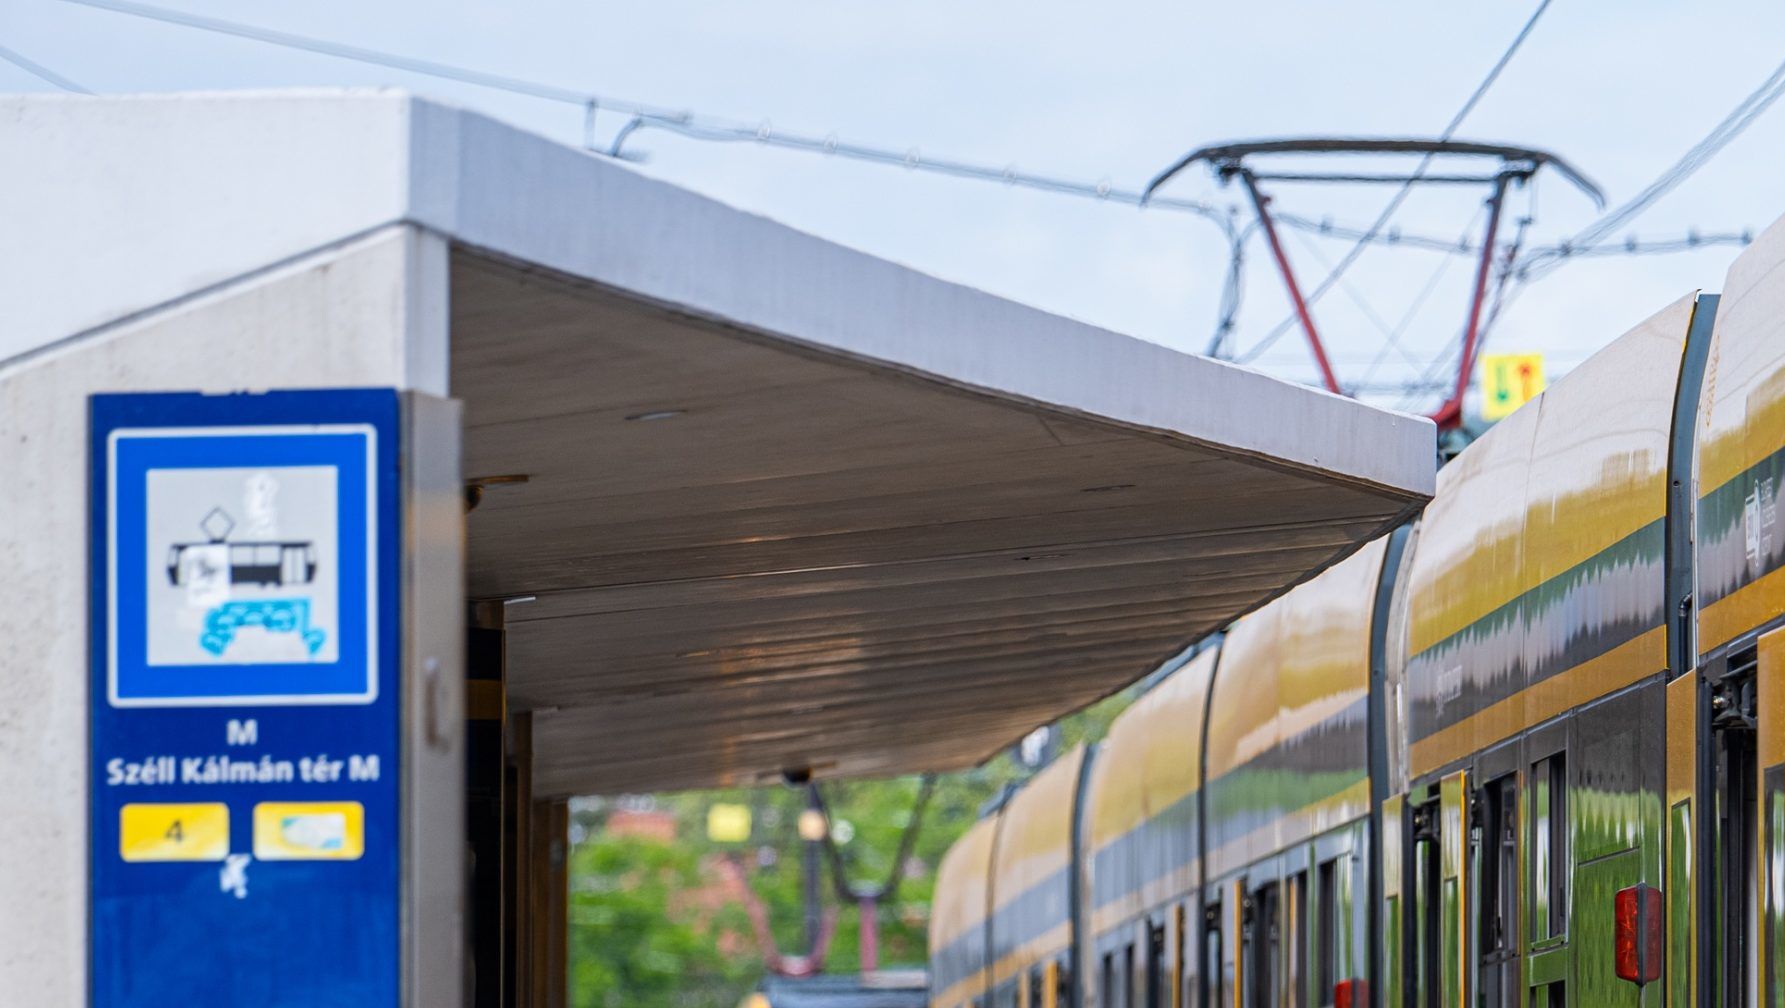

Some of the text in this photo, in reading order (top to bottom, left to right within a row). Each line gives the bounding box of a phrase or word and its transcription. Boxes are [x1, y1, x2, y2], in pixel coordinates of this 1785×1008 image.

[226, 719, 258, 746] M
[106, 754, 381, 786] Széll Kálmán tér M
[165, 819, 185, 843] 4
